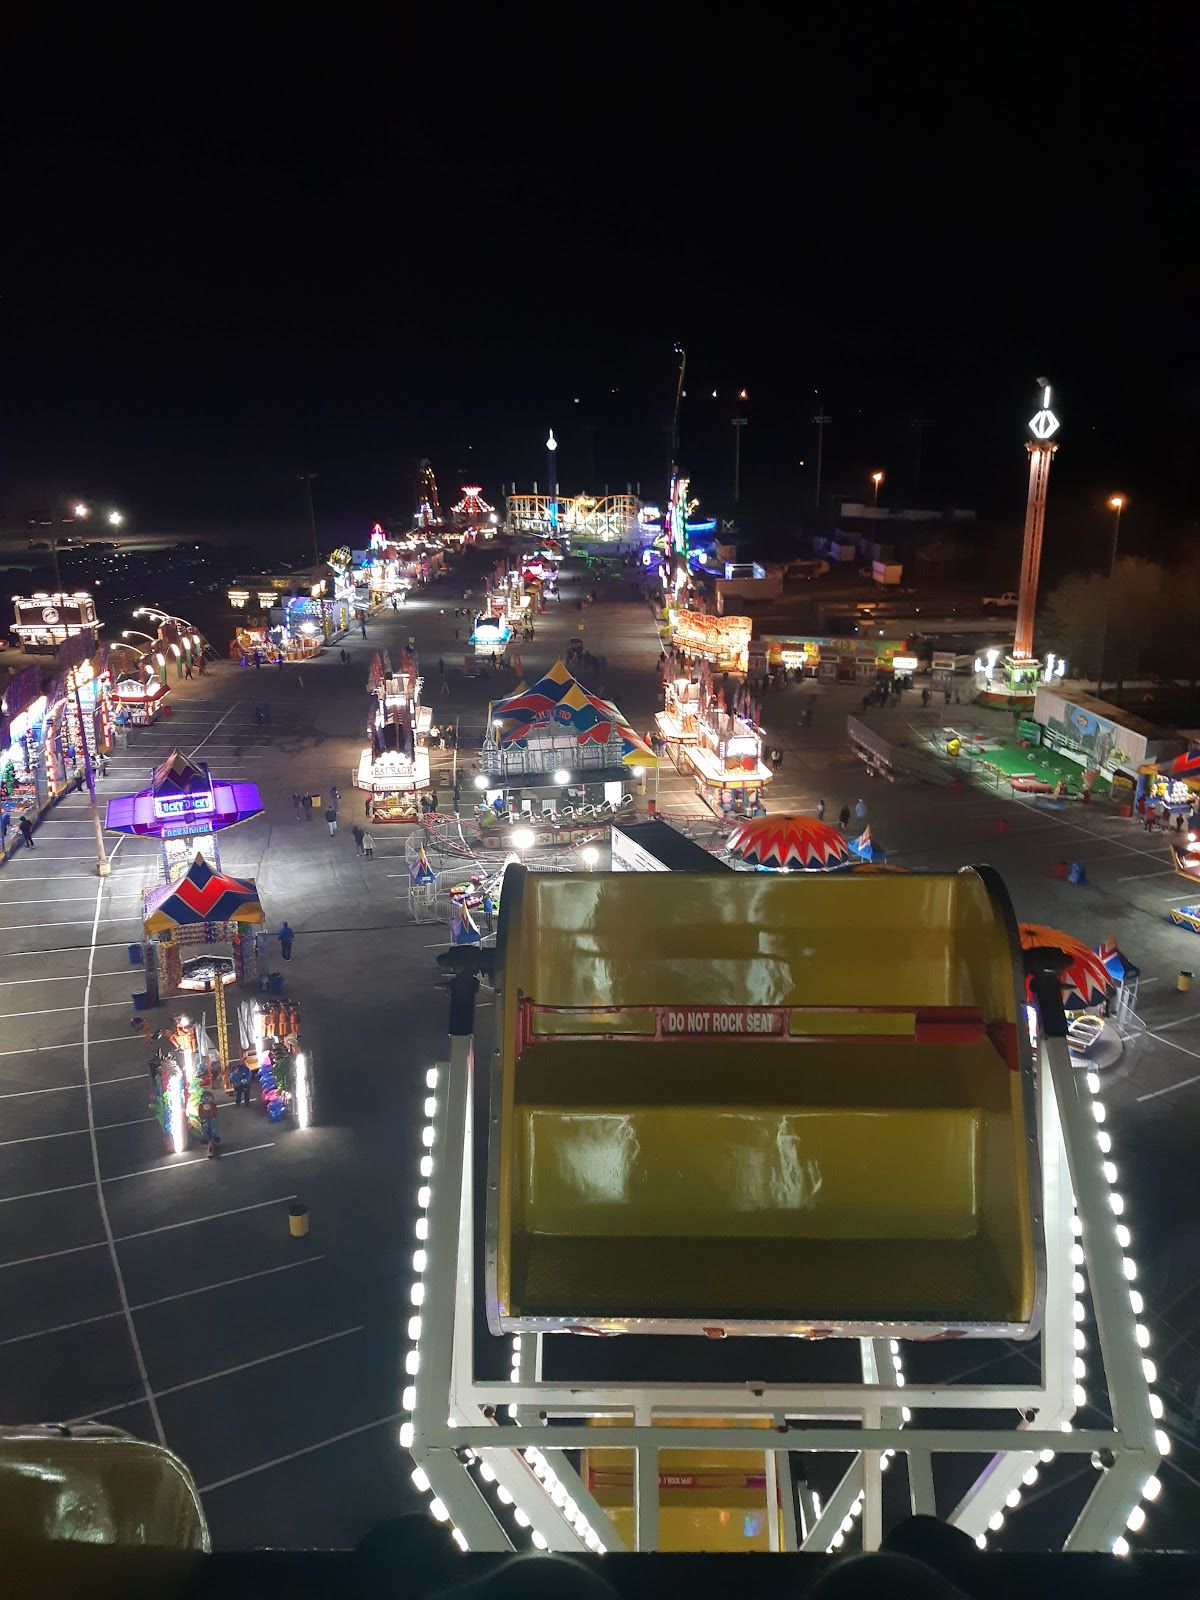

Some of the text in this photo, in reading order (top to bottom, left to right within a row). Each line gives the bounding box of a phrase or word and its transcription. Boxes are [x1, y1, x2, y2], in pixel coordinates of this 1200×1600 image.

[20, 601, 52, 609] WELCOME
[374, 766, 413, 775] SAUSAGE
[668, 1012, 774, 1033] DO NOT ROCK SEAT
[667, 1477, 680, 1485] ROCK
